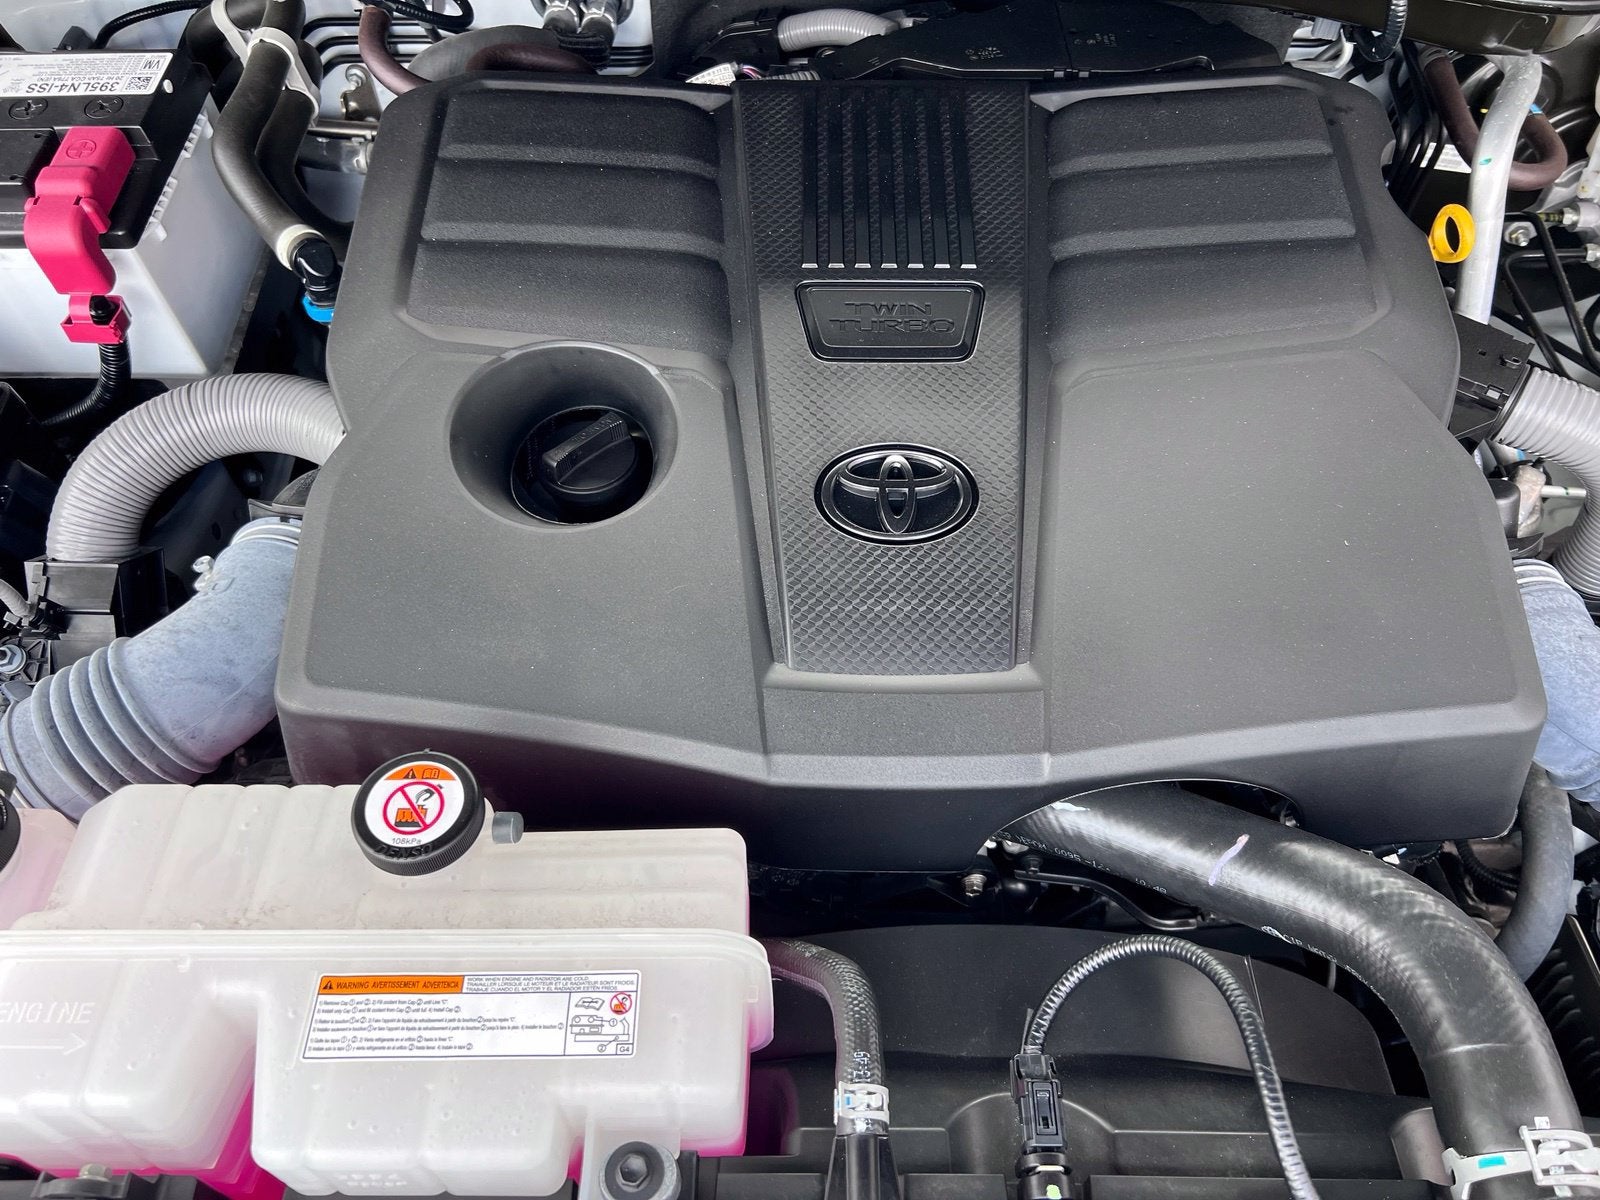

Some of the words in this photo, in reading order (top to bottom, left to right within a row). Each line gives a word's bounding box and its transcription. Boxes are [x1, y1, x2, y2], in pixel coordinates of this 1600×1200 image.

[142, 59, 161, 70] VM
[26, 81, 120, 94] 395LN4-ISS
[844, 301, 933, 317] TWIN
[829, 318, 956, 334] TURBO
[391, 837, 422, 845] 108kPa
[336, 981, 369, 990] WARNING
[371, 981, 420, 989] AVERTISSEMENT
[422, 980, 459, 989] ADVERTENCIA
[0, 1002, 96, 1024] ENGINE
